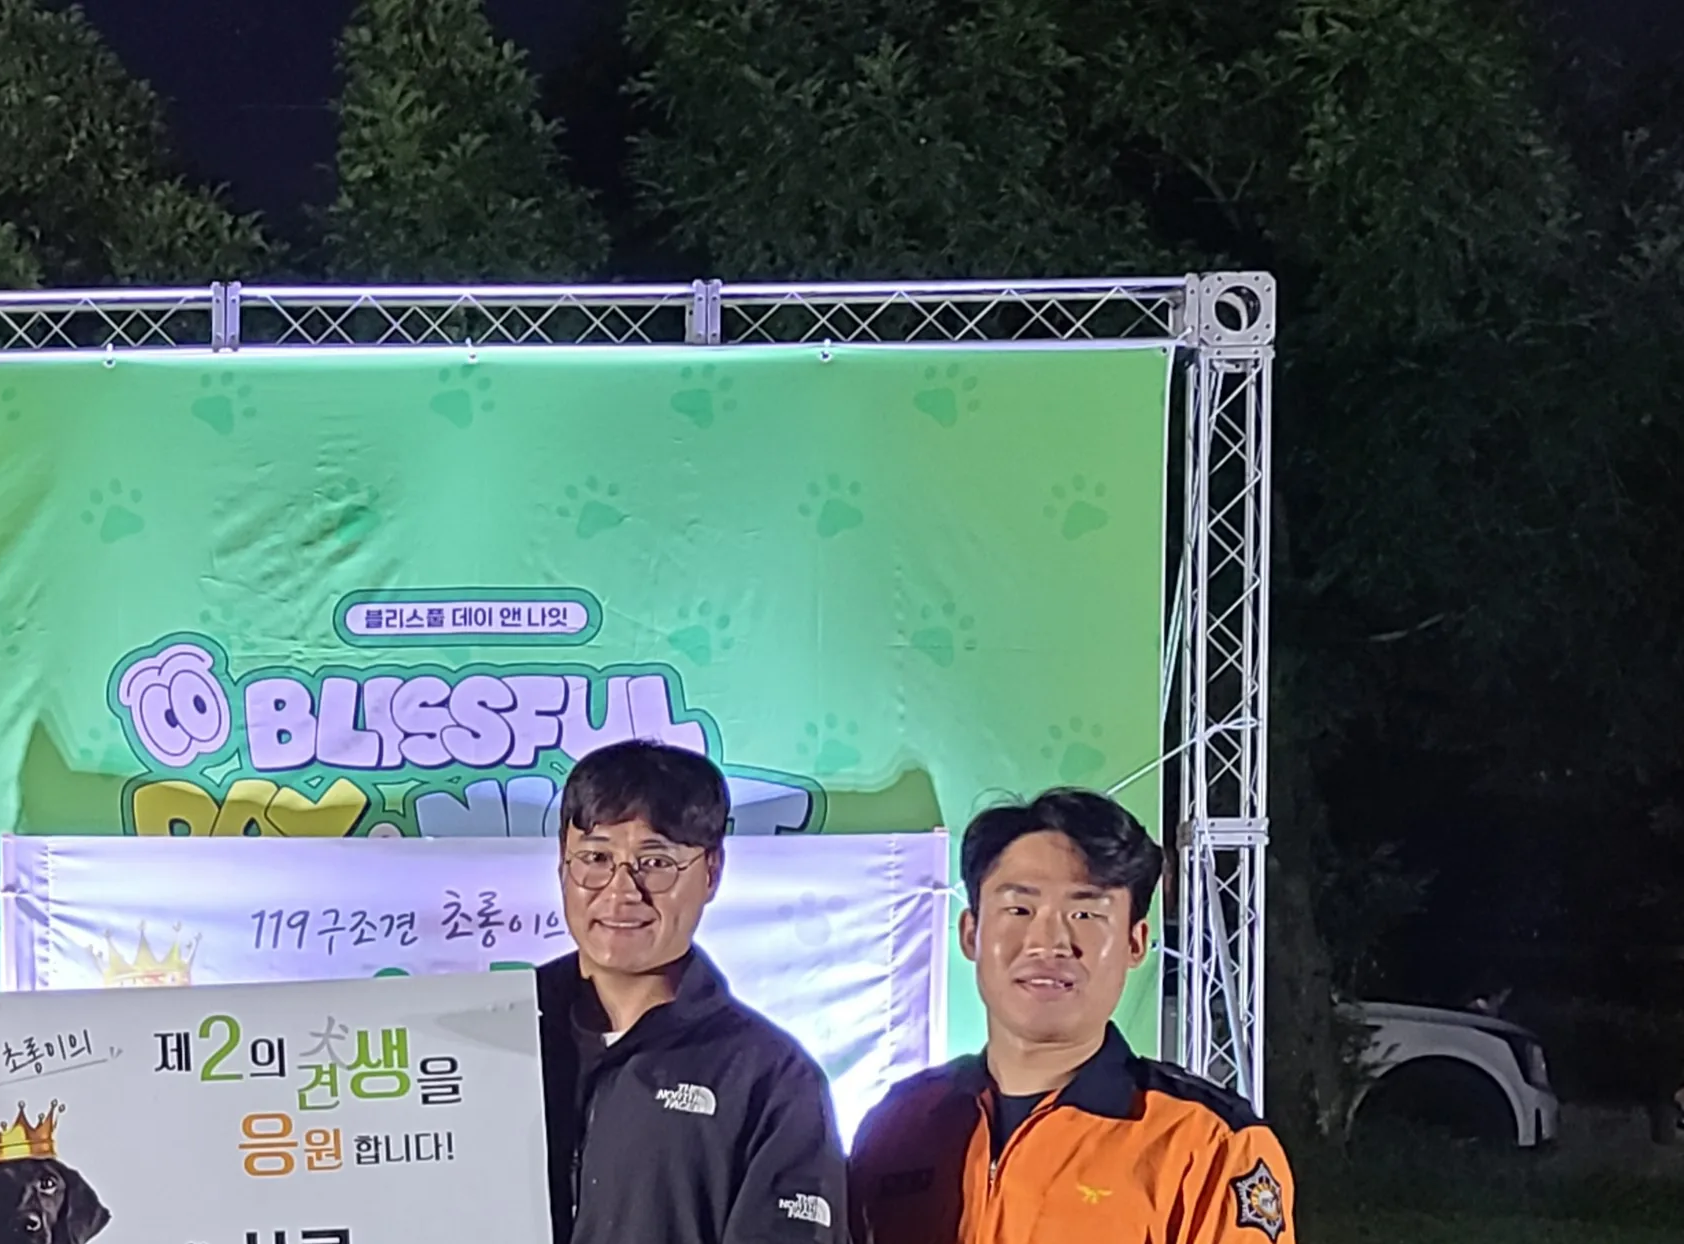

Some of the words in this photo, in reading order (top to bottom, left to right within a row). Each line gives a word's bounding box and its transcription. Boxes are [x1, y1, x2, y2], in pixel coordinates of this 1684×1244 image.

[365, 608, 445, 629] 블리스풀
[452, 607, 493, 628] 데이
[500, 607, 522, 628] 앤
[527, 606, 568, 628] 나잇
[245, 674, 707, 770] BLISSFUL
[251, 908, 418, 955] 119구조견
[2, 1029, 93, 1075] 초롱이의
